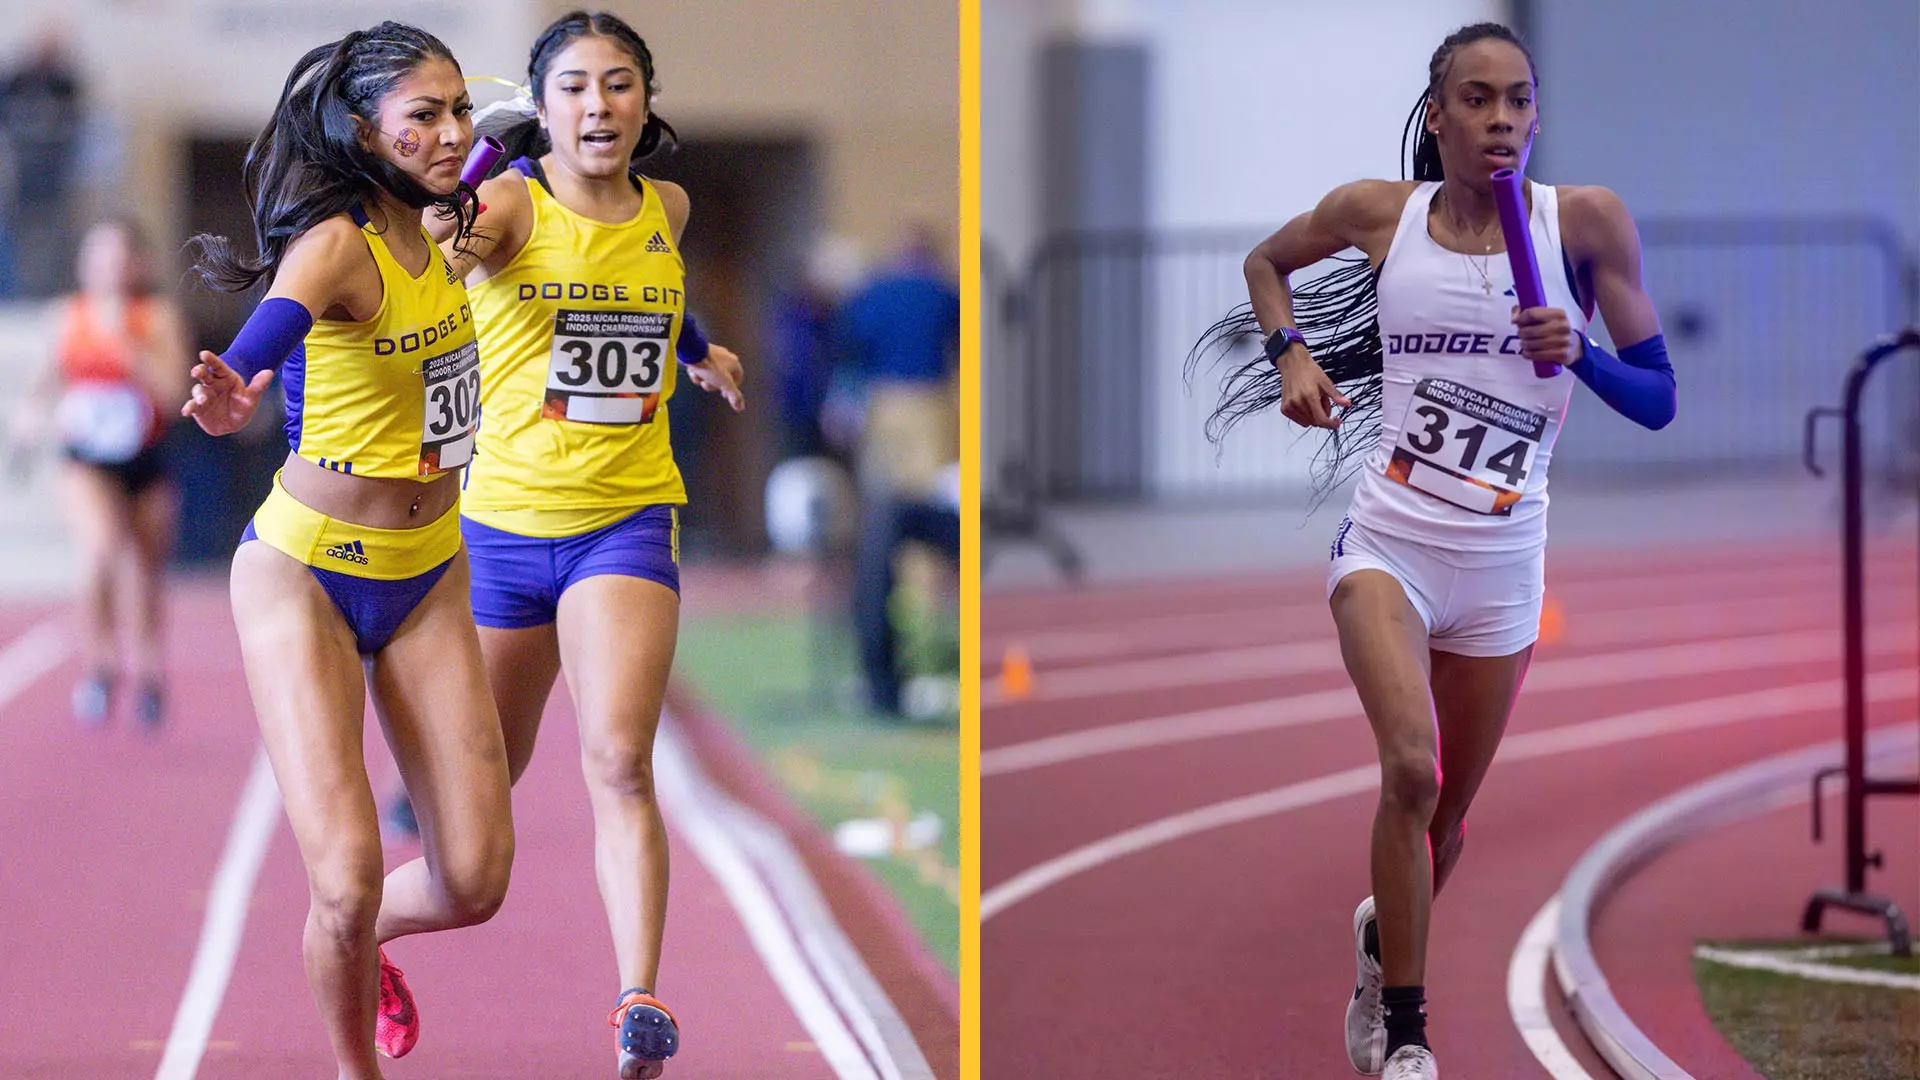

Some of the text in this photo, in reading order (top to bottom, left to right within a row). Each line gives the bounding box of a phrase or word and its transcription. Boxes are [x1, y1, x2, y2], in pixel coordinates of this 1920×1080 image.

[518, 282, 630, 302] DODGE
[566, 323, 665, 334] INDOOR CHAMPIONSHIP
[567, 313, 591, 323] 2025
[593, 314, 619, 323] NJCAA
[621, 315, 655, 324] REGION
[374, 312, 458, 356] DODGE
[1388, 333, 1495, 355] DODGE
[428, 364, 452, 380] INDOOR
[429, 357, 444, 370] 2025
[555, 340, 661, 388] 303
[429, 369, 480, 436] 302
[1426, 386, 1536, 434] INDOOR CHAMPIONSHIP
[1430, 379, 1456, 394] 2025
[1457, 388, 1490, 407] NJCAA
[1491, 400, 1529, 421] REGION
[1407, 405, 1531, 487] 314
[326, 548, 369, 566] adidas
